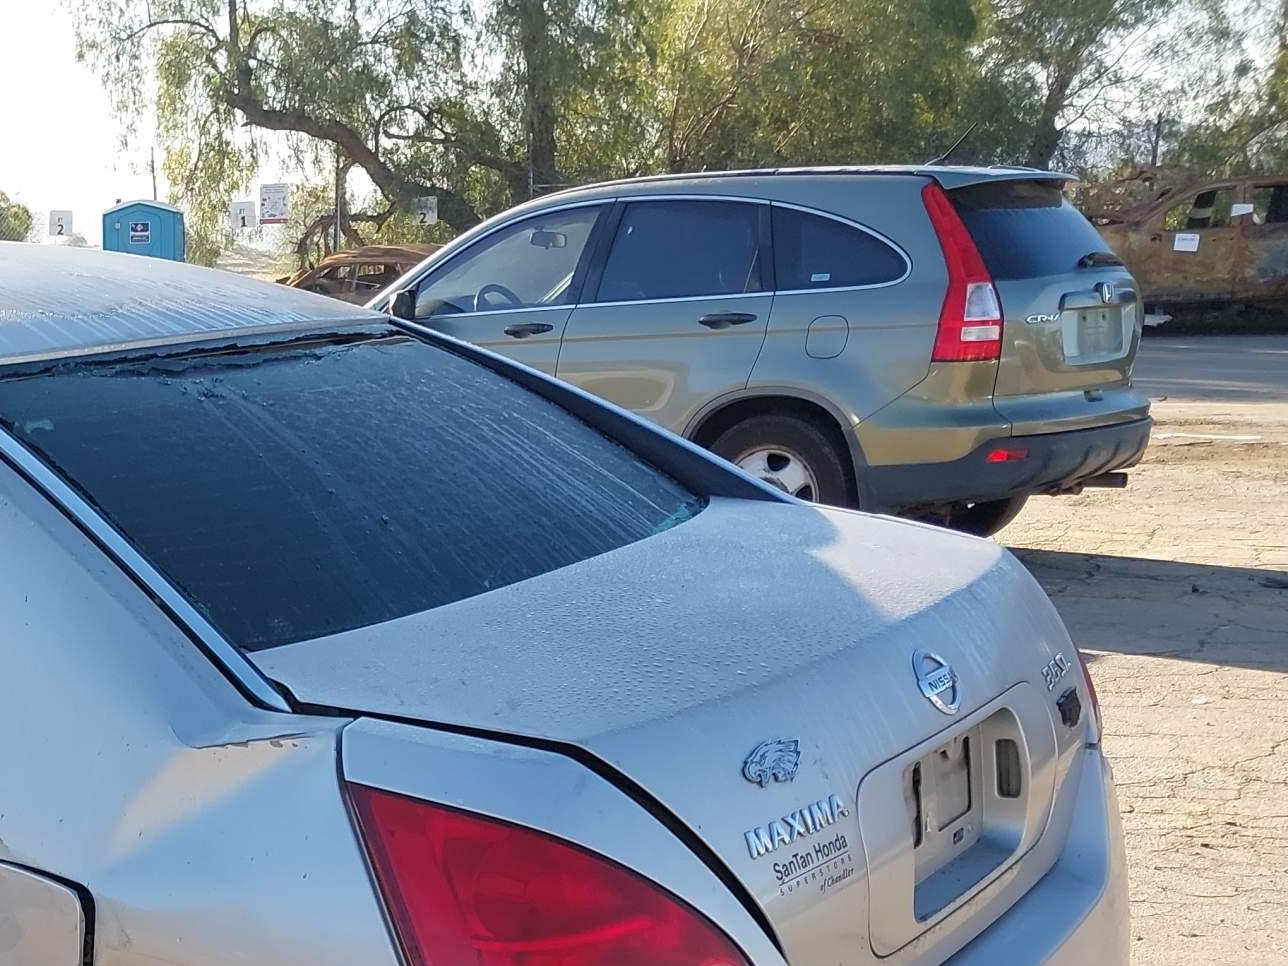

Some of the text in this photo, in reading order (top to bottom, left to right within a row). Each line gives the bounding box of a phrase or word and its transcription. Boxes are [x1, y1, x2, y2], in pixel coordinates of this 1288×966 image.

[419, 212, 427, 224] 2
[57, 223, 65, 236] 2
[744, 794, 849, 860] MAXIMA
[773, 833, 848, 881] SanTan Honda
[826, 867, 854, 888] Chandler
